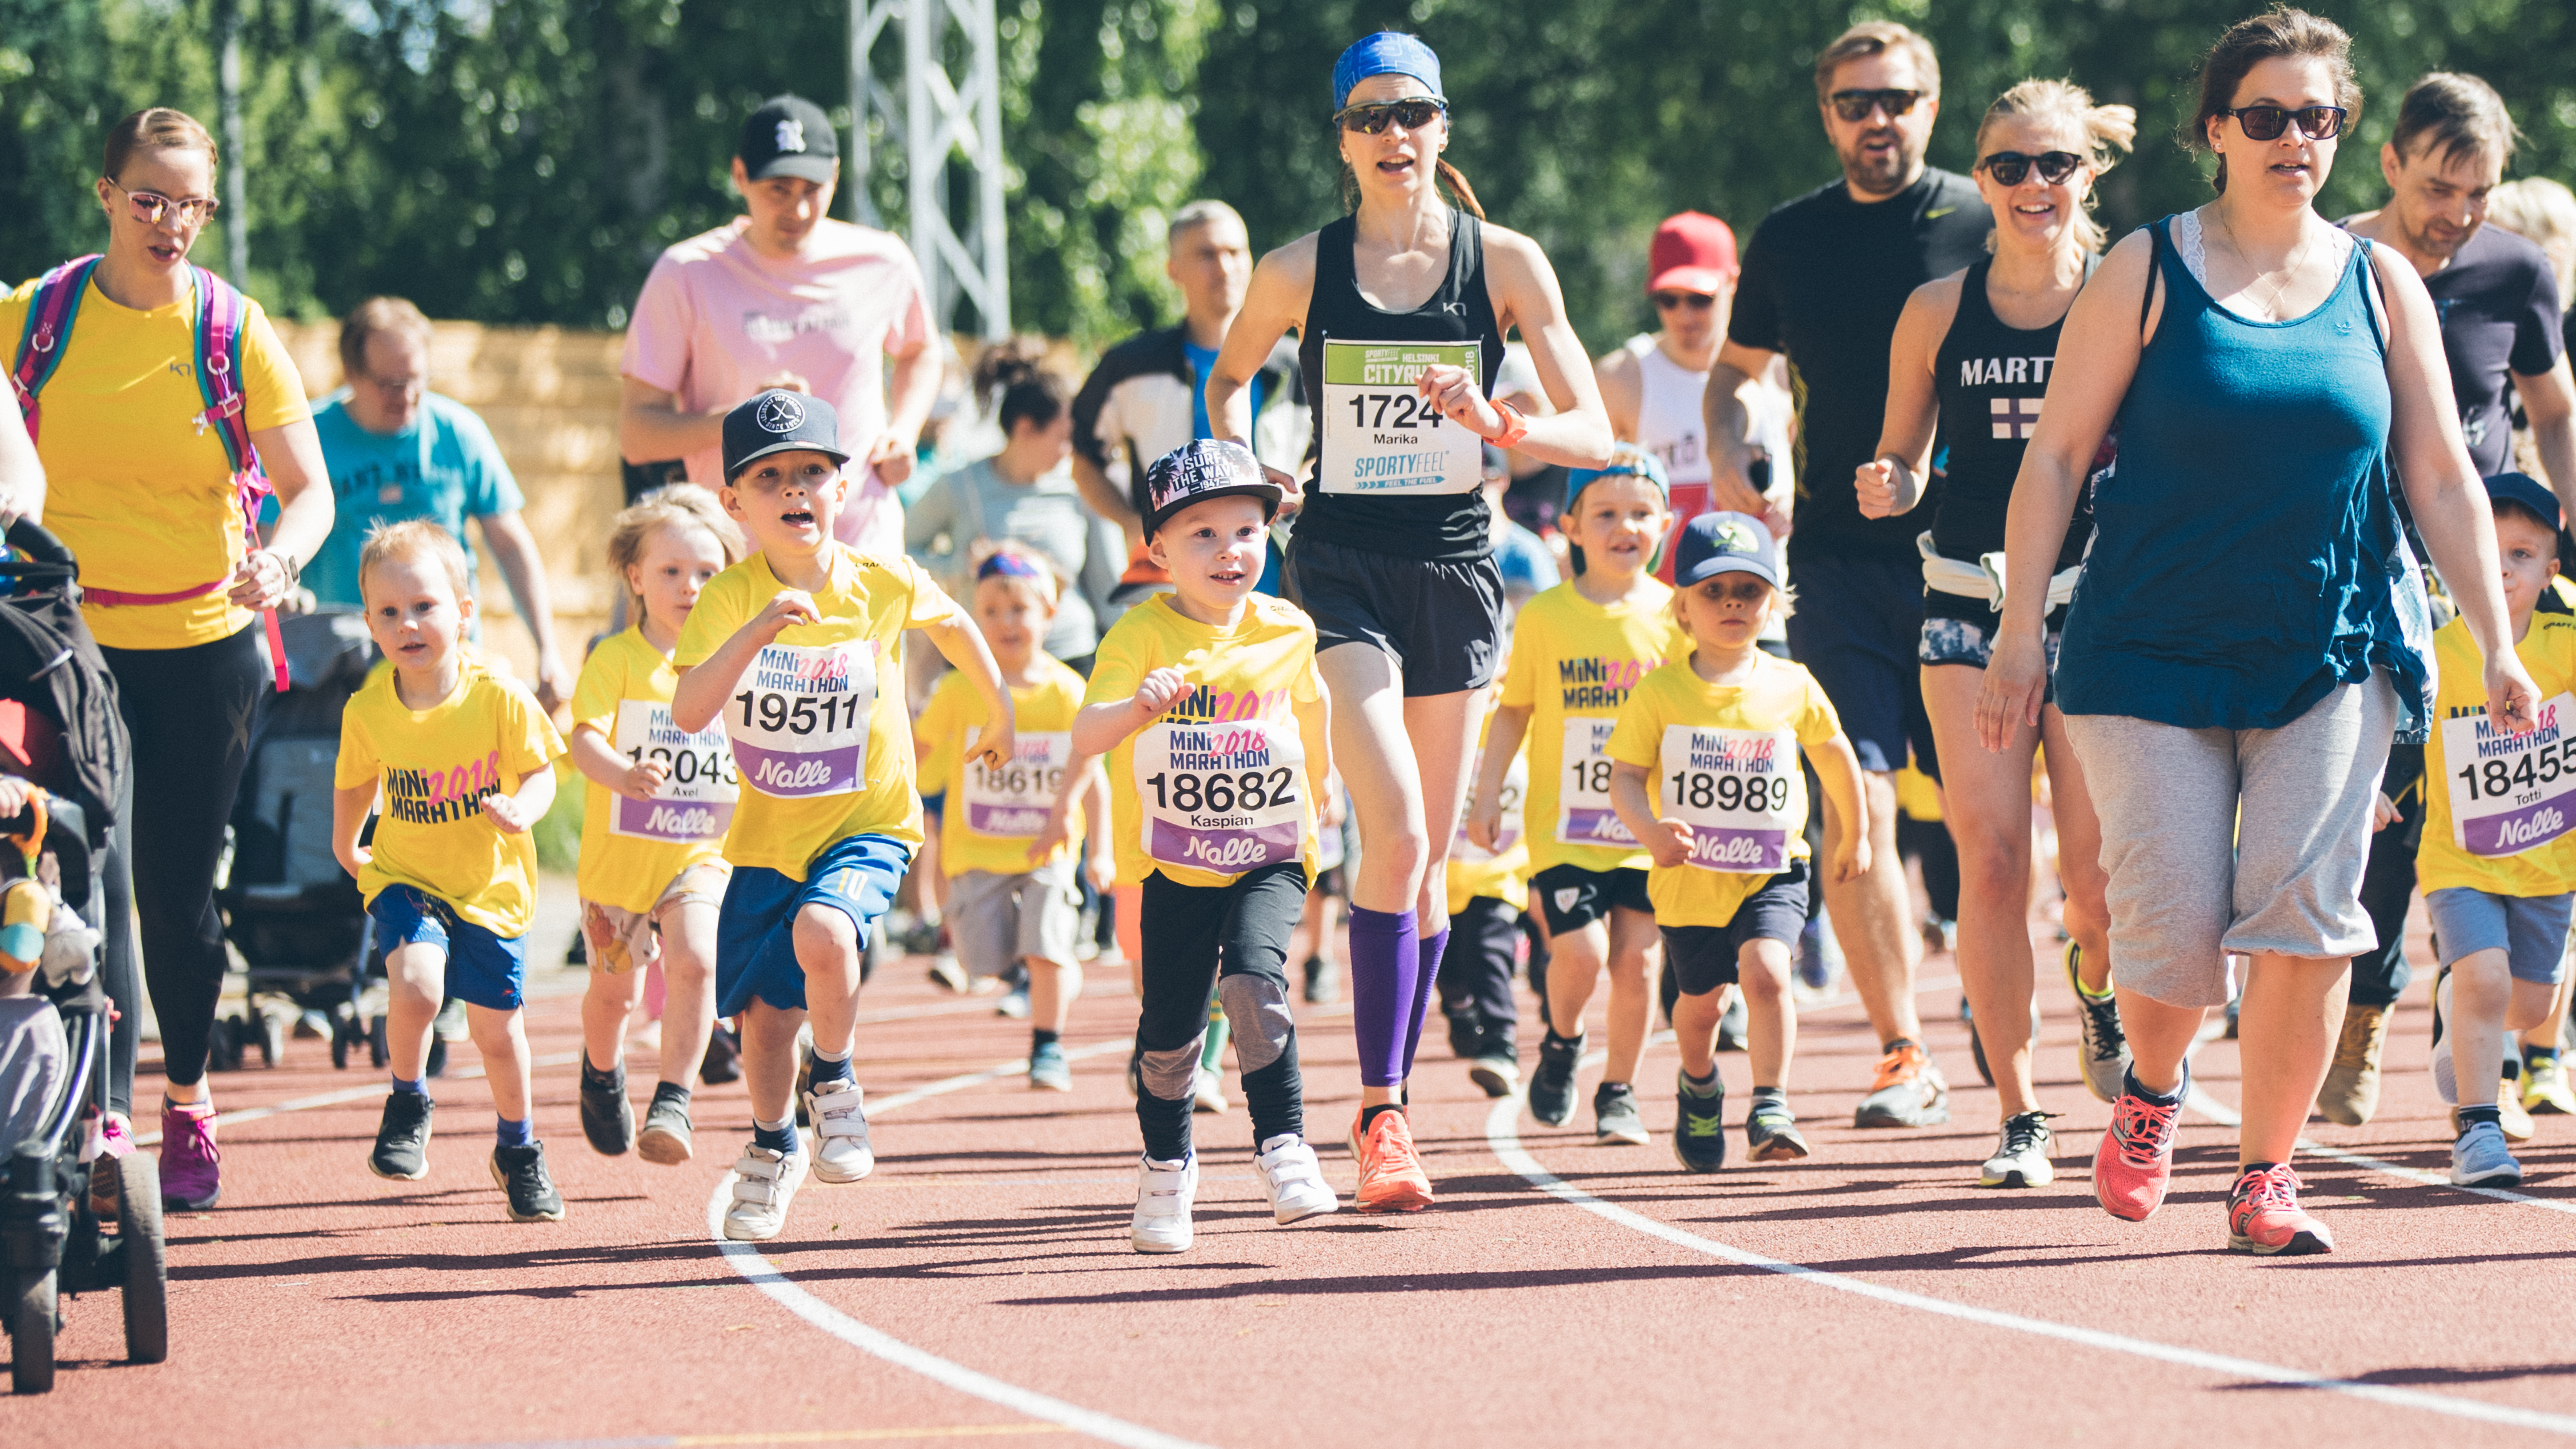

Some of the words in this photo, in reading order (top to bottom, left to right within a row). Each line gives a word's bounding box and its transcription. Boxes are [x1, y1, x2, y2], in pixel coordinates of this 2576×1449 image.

[1402, 353, 1440, 363] HELSINKI
[1349, 394, 1443, 428] 1724
[1373, 434, 1418, 445] Marika
[1184, 451, 1221, 471] SURF
[1354, 452, 1445, 478] SPORTYFEEL
[1172, 469, 1199, 491] THE
[1201, 465, 1240, 481] WAVE
[756, 669, 848, 693] MARATHON
[793, 653, 848, 681] 2018
[735, 690, 859, 735] 19511
[1207, 727, 1267, 758] 2018
[1723, 738, 1775, 759] 2018
[2477, 724, 2560, 758] MARATHON
[755, 758, 832, 788] Nalle
[1170, 748, 1270, 770] MARATHON
[1690, 753, 1774, 773] MARATHON
[2458, 735, 2576, 800] 18455
[426, 750, 499, 807] 2018
[672, 785, 699, 798] Axel
[1146, 766, 1296, 812] 18682
[1671, 770, 1788, 812] 18989
[2514, 788, 2542, 806] Totti
[644, 804, 717, 835] Nalle
[1190, 814, 1254, 829] Kaspian
[2495, 806, 2564, 848] Nalle
[1183, 835, 1267, 866] Nalle
[1691, 834, 1764, 864] Nalle
[837, 866, 869, 901] 10
